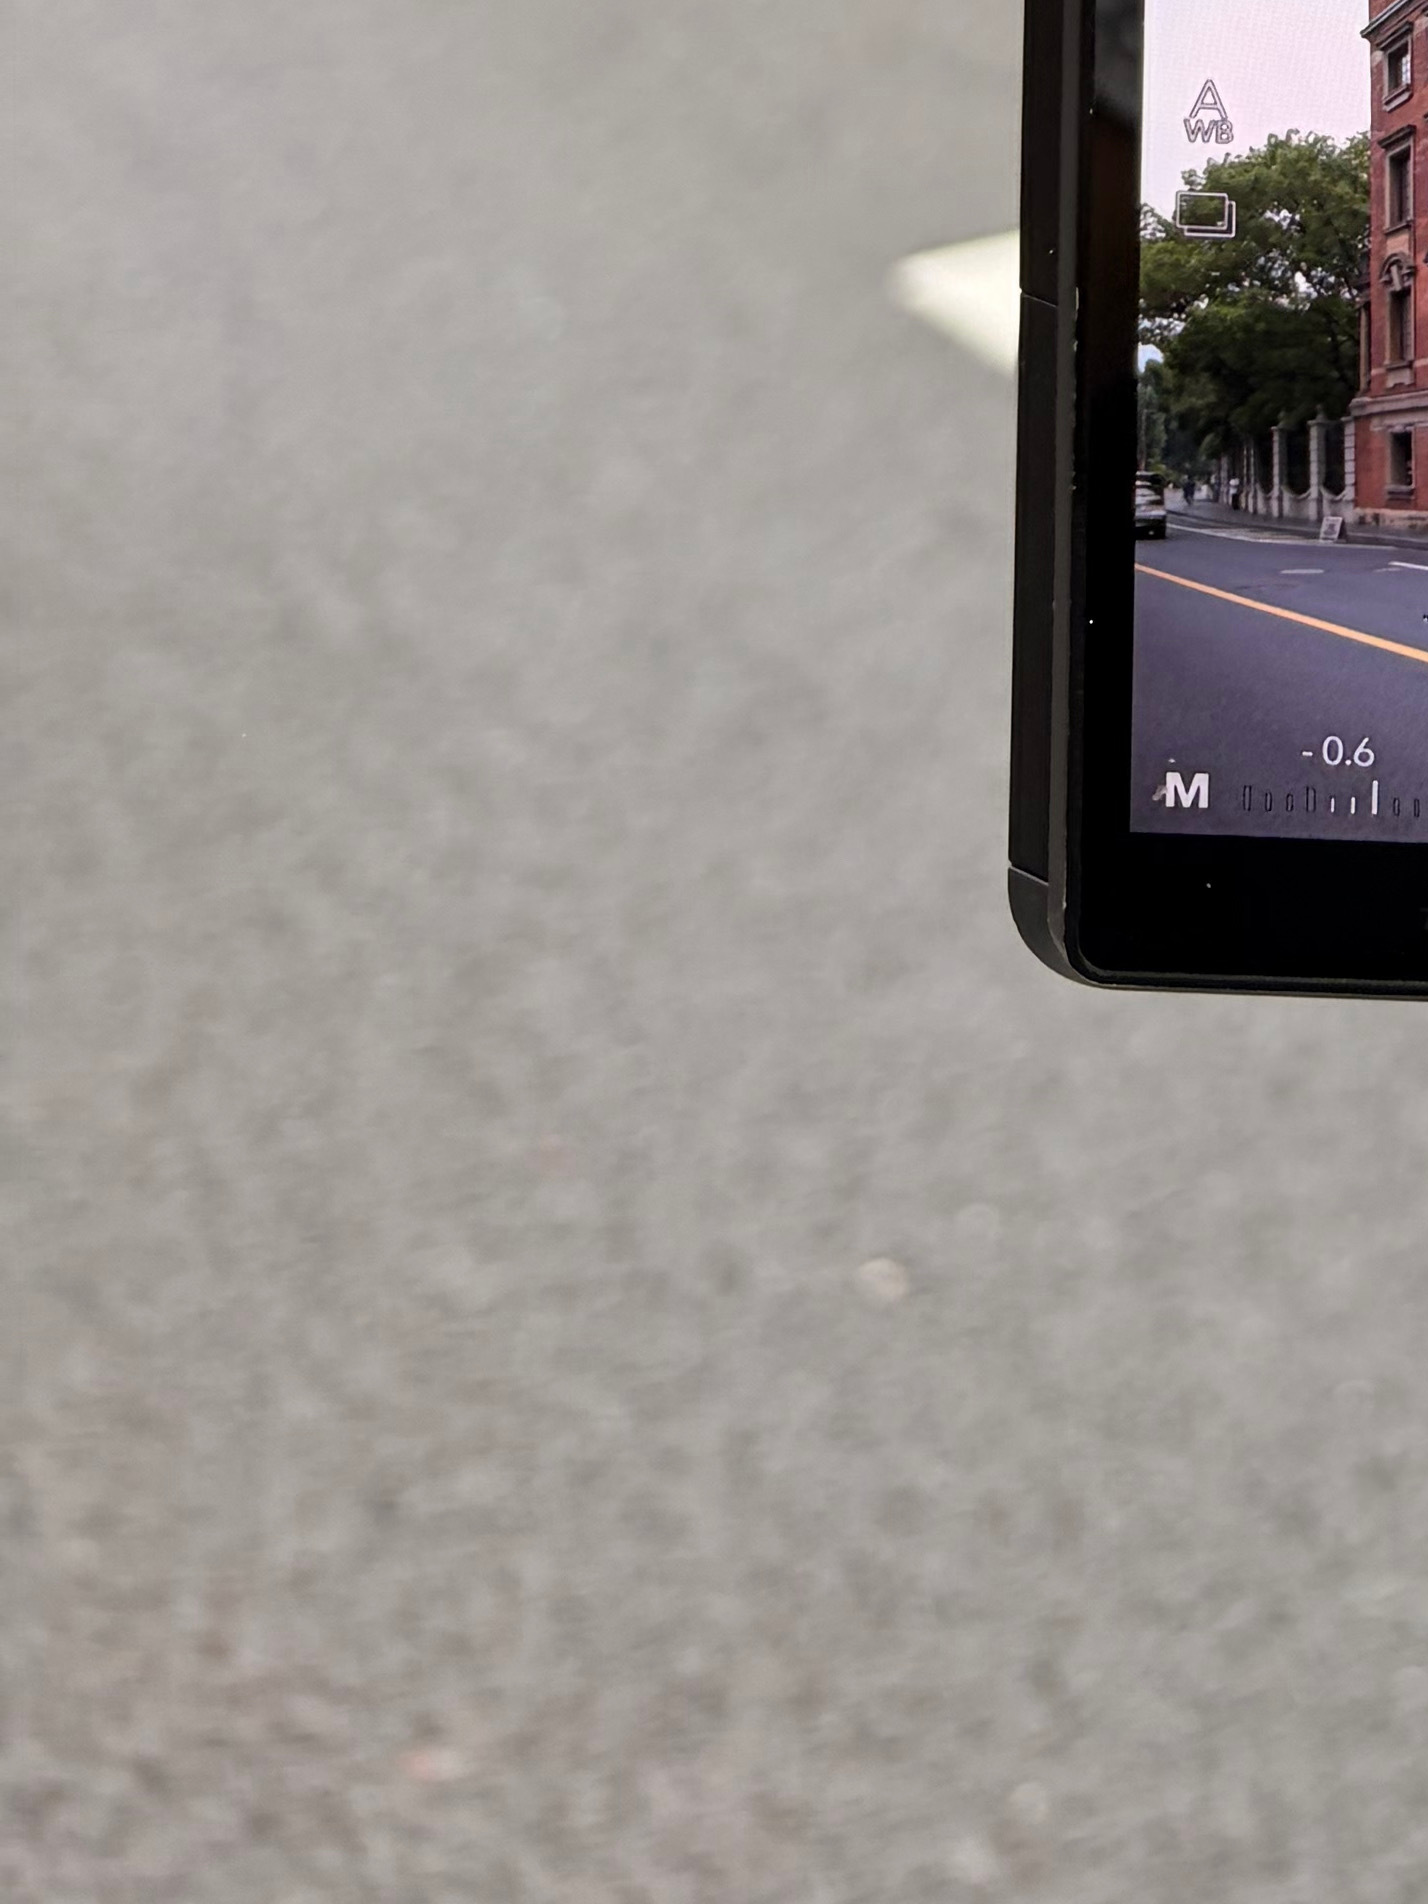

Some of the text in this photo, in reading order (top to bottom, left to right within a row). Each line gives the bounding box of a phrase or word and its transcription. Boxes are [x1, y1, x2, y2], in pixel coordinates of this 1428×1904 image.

[1183, 117, 1235, 145] WB
[1301, 735, 1376, 768] -0.6
[1164, 771, 1210, 810] M
